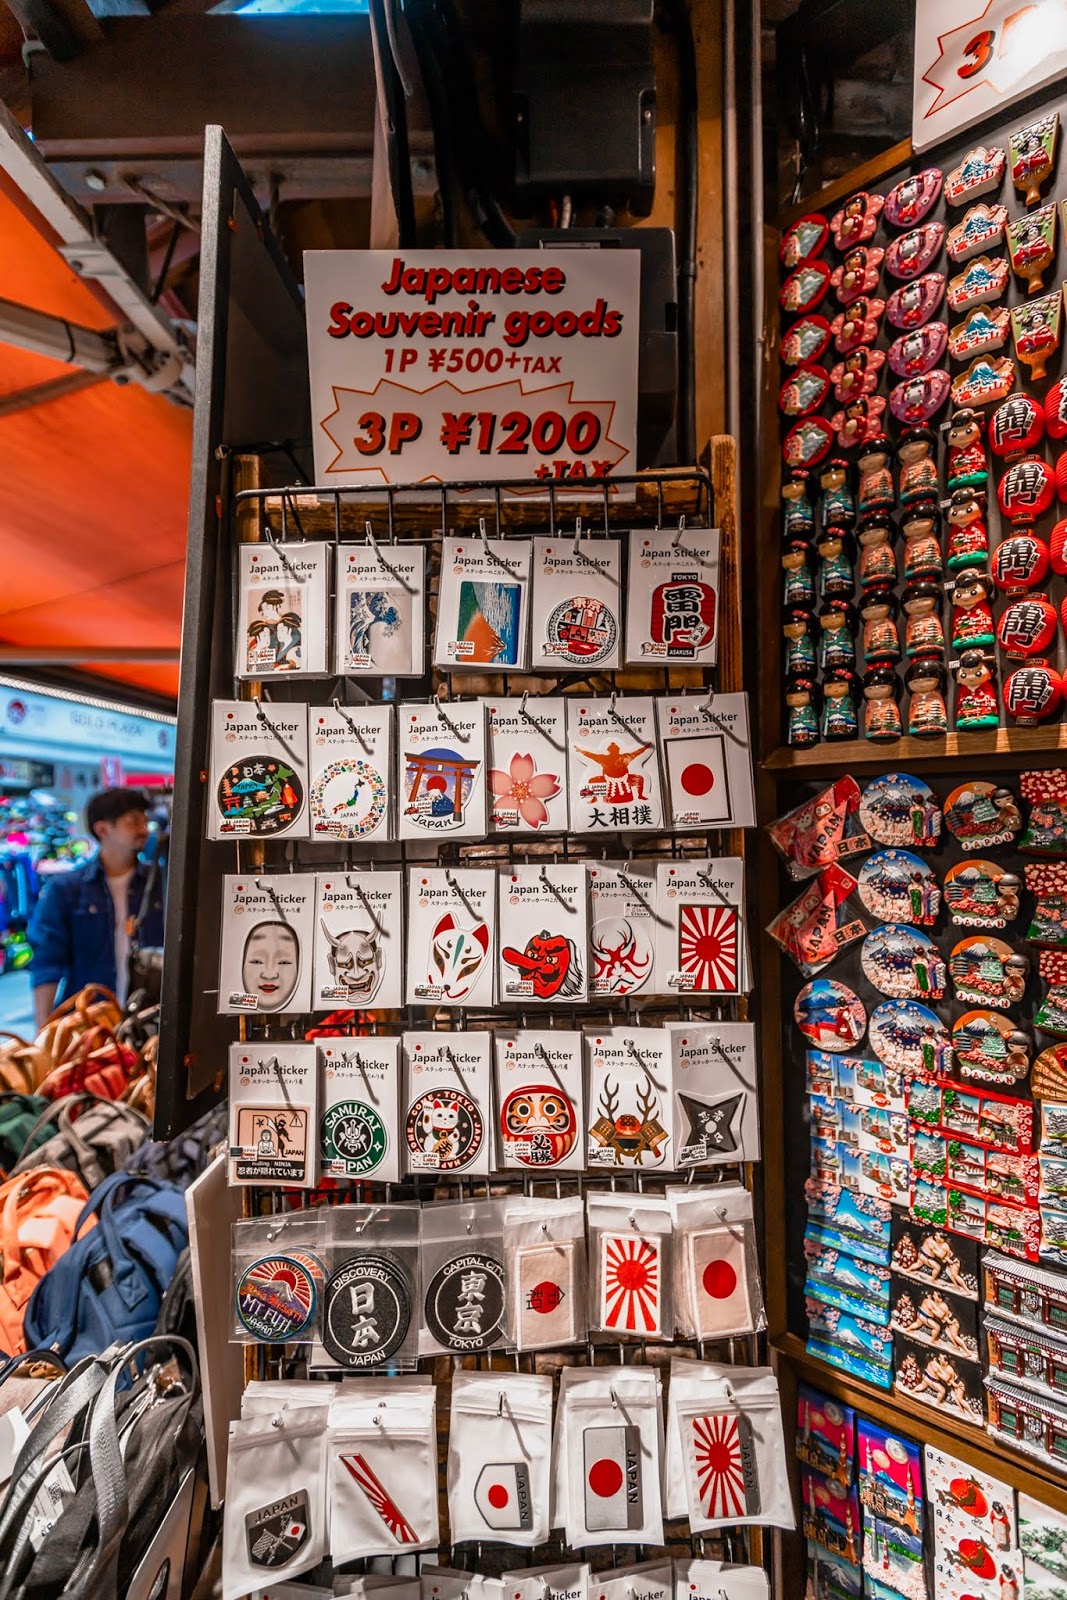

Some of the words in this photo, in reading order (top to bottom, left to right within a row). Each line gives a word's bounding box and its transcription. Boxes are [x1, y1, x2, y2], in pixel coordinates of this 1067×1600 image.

[957, 30, 995, 79] 3
[952, 170, 995, 196] 富士山
[955, 227, 998, 252] 富士山
[380, 258, 566, 305] Japanese
[956, 280, 1000, 303] 富士山
[327, 299, 495, 339] Souvenir
[503, 298, 623, 347] goods
[956, 331, 1000, 352] 富士山
[384, 348, 418, 373] 1P
[428, 348, 563, 374] ¥500+TAX
[960, 379, 1004, 400] 富士山
[353, 411, 422, 456] 3P
[440, 410, 602, 456] ¥1200
[640, 548, 672, 559] Japan
[674, 547, 711, 558] Sticker
[250, 564, 279, 574] Japan
[282, 561, 318, 572] Sticker
[347, 565, 377, 575] Japan
[380, 563, 415, 574] Sticker
[453, 556, 484, 567] Japan
[487, 557, 522, 568] Sticker
[543, 556, 574, 568] Japan
[576, 556, 612, 568] Sticker
[673, 573, 697, 581] TOKYO
[572, 596, 604, 613] 東京
[663, 586, 704, 643] 雷門
[224, 722, 257, 733] Japan
[261, 721, 299, 731] Sticker
[488, 716, 519, 727] Japan
[521, 716, 557, 726] Sticker
[578, 715, 608, 727] Japan
[611, 714, 647, 725] Sticker
[668, 716, 699, 726] Japan
[702, 712, 738, 724] Sticker
[315, 726, 345, 737] Japan
[348, 725, 382, 735] Sticker
[408, 724, 438, 735] Japan
[441, 722, 476, 732] Sticker
[242, 763, 266, 778] 日本
[340, 811, 358, 819] JAPAN
[412, 814, 453, 829] Japan
[587, 805, 653, 828] 大相撲
[807, 812, 843, 864] JAPAN
[837, 836, 869, 852] 日本
[964, 833, 1014, 850] JAPAN
[508, 885, 539, 895] Japan
[542, 885, 578, 895] Sticker
[588, 880, 617, 890] Japan
[619, 880, 653, 889] Sticker
[666, 878, 697, 889] Japan
[699, 878, 735, 889] Sticker
[233, 894, 266, 905] Japan
[269, 894, 307, 904] Sticker
[322, 892, 353, 902] Japan
[356, 891, 393, 901] Sticker
[418, 888, 449, 899] Japan
[451, 888, 487, 898] Sticker
[955, 917, 1005, 928] JAPAN
[806, 904, 834, 958] JAPAN
[833, 924, 864, 943] 日本
[958, 991, 1009, 1008] JAPAN
[412, 1053, 443, 1065] Japan
[446, 1053, 482, 1064] Sticker
[504, 1050, 535, 1061] Japan
[538, 1051, 573, 1061] Sticker
[593, 1047, 624, 1059] Japan
[627, 1048, 663, 1060] Sticker
[679, 1047, 708, 1058] Japan
[711, 1044, 747, 1055] Sticker
[239, 1065, 270, 1077] Japan
[273, 1065, 308, 1075] Sticker
[323, 1059, 353, 1070] Japan
[356, 1059, 390, 1070] Sticker
[962, 1068, 1014, 1085] JAPAN
[411, 1094, 434, 1116] COME
[444, 1091, 474, 1112] TOKYO
[325, 1104, 381, 1132] SAMURAI
[467, 1122, 481, 1155] JAPAN
[530, 1134, 553, 1164] 必勝
[441, 1159, 461, 1169] HAP
[237, 1167, 305, 1178] 忍者が隠れています
[443, 1257, 485, 1276] CAPITAL
[332, 1267, 393, 1291] DISCOVERY
[453, 1271, 488, 1334] 東京
[526, 1285, 566, 1310] 令和
[242, 1293, 265, 1315] MT
[263, 1307, 292, 1333] FUJI
[349, 1282, 381, 1348] 日本
[246, 1315, 273, 1336] JAPAN
[448, 1336, 484, 1349] TOKYO
[348, 1350, 387, 1366] JAPAN
[741, 1442, 754, 1489] JAPAN
[926, 1451, 945, 1465] 日本
[626, 1449, 639, 1504] JAPAN
[516, 1471, 529, 1521] JAPAN
[254, 1496, 299, 1525] JAPAN
[936, 1509, 955, 1523] 日本
[936, 1564, 955, 1578] 日本
[548, 1589, 583, 1600] ticker
[636, 1590, 665, 1600] ticker
